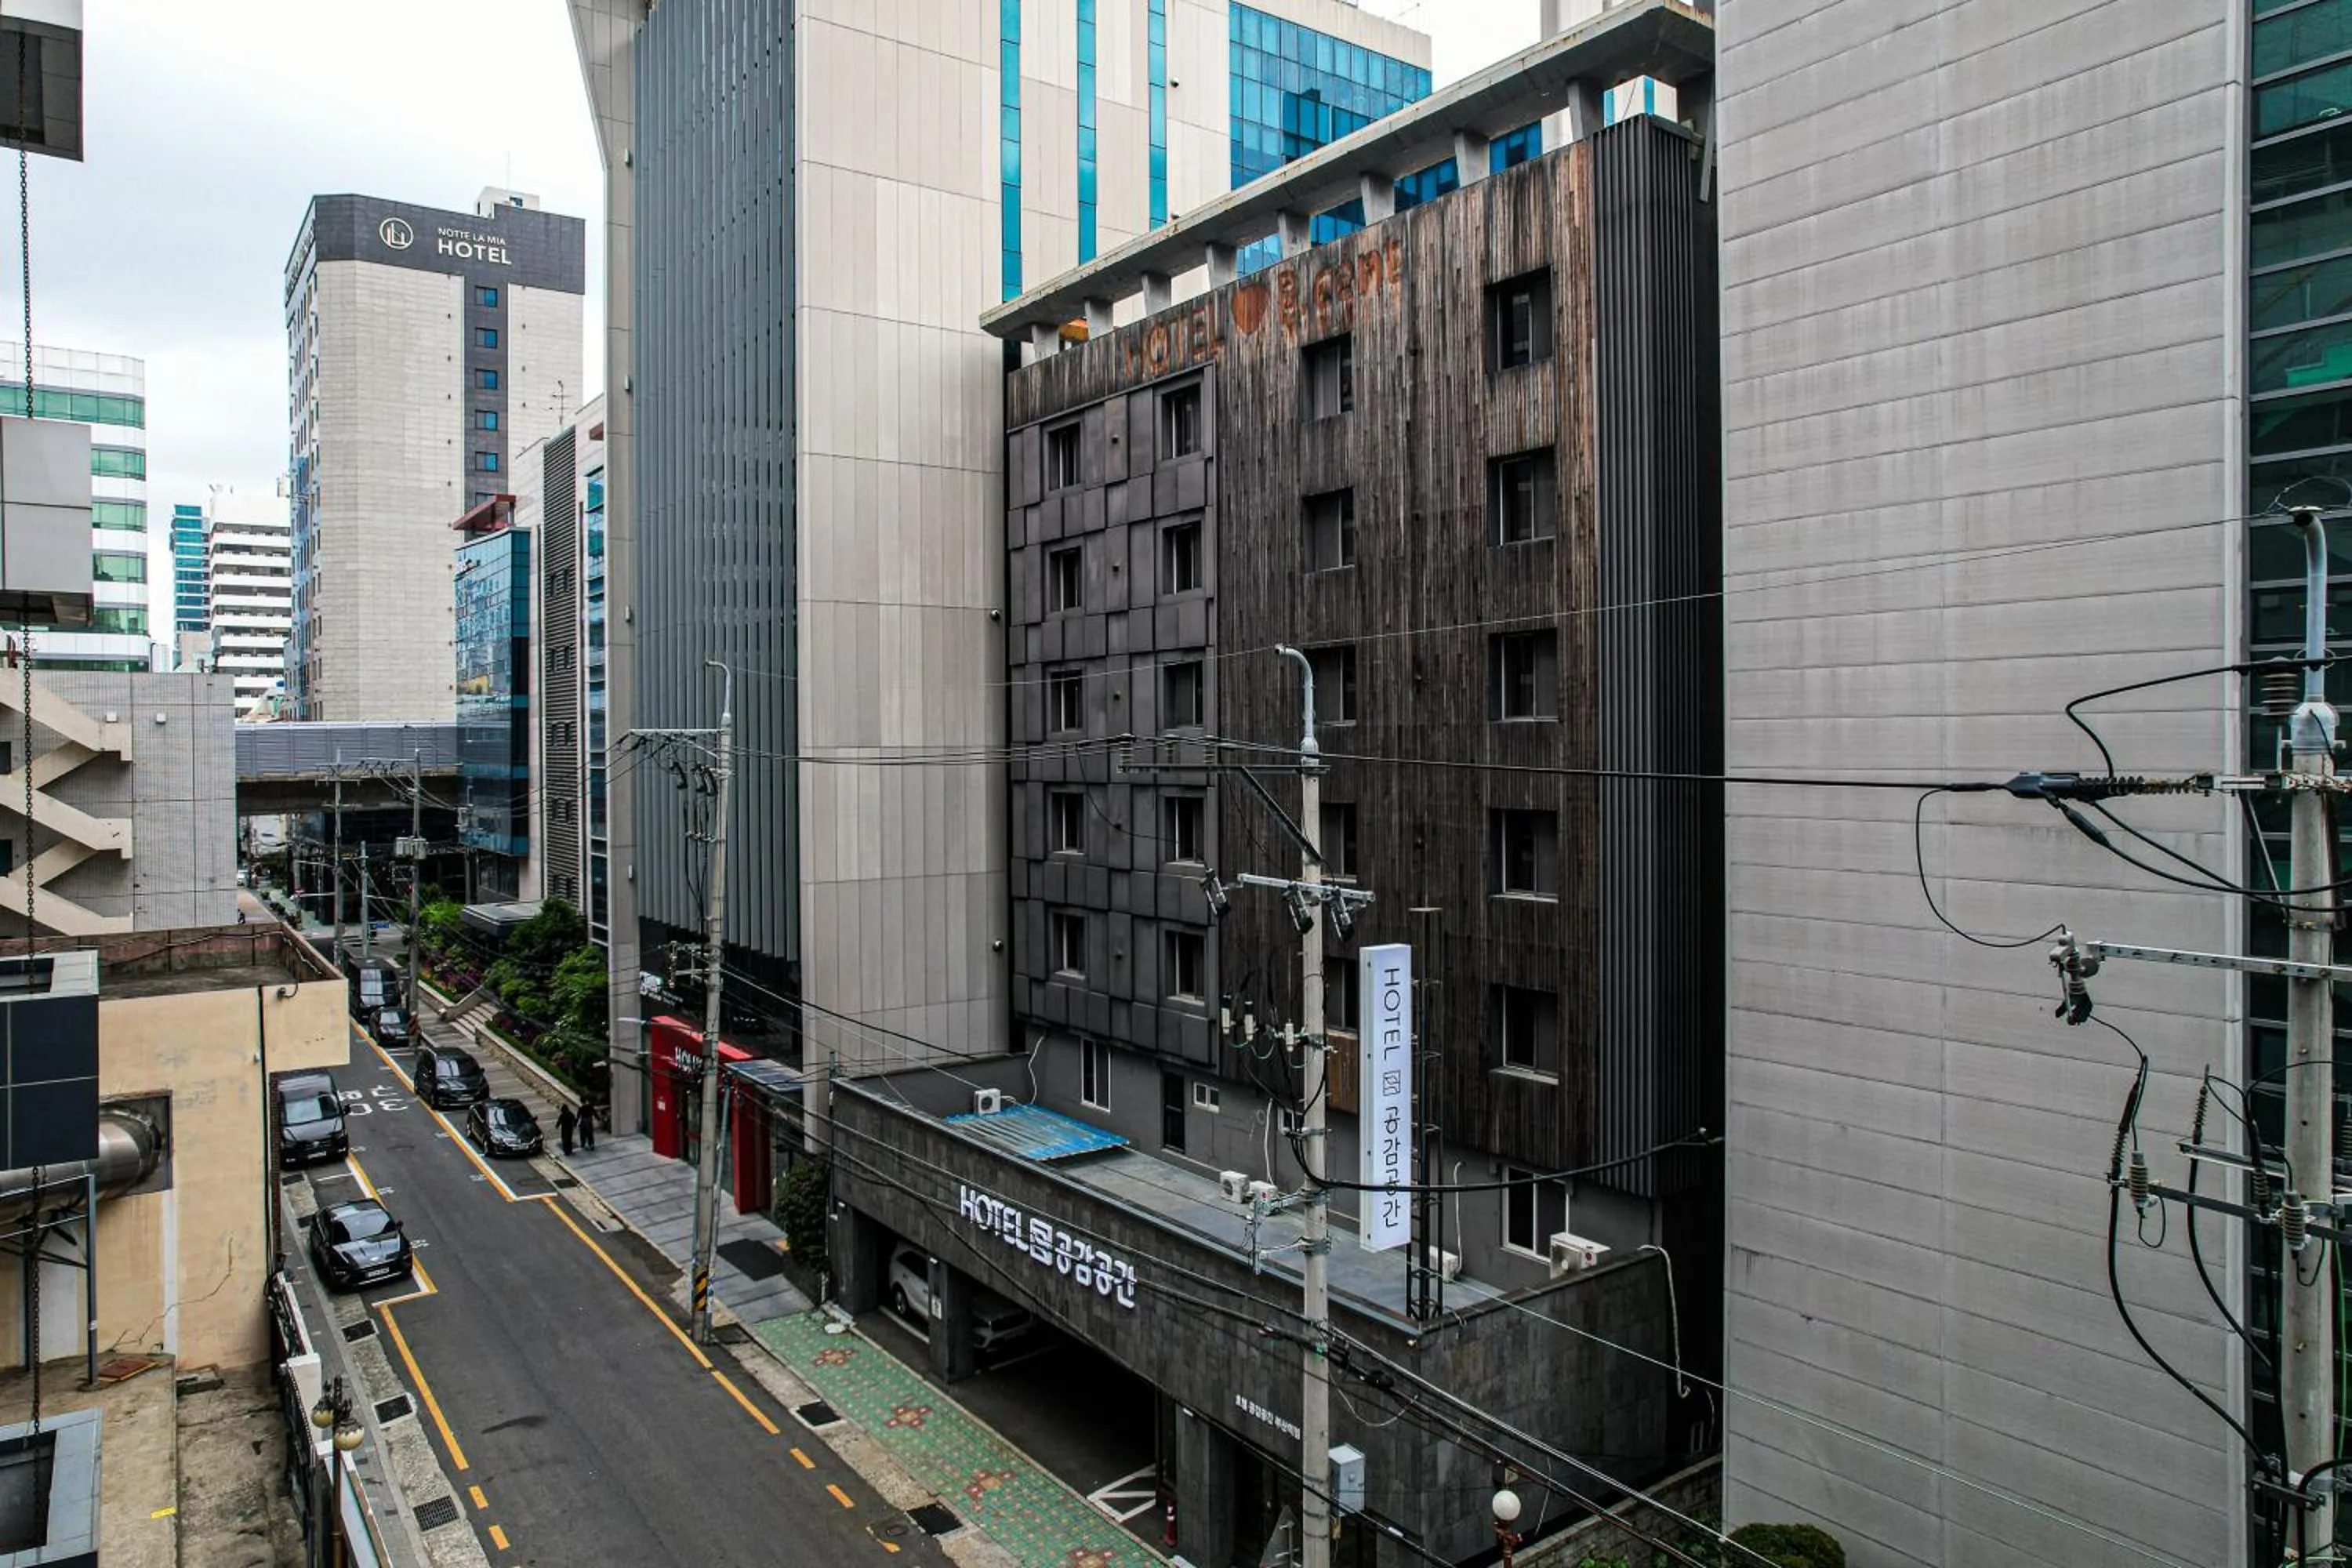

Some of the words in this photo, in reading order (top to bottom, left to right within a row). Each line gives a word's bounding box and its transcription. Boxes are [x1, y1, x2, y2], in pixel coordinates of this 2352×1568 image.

[438, 227, 470, 240] NOTTE
[473, 232, 485, 242] LA
[488, 236, 506, 245] MIA
[438, 238, 512, 265] HOTEL
[1384, 967, 1401, 1062] HOTEL
[1382, 1106, 1402, 1229] 공감공간
[960, 1185, 1029, 1252] HOTEL
[1054, 1231, 1138, 1308] 공감공간
